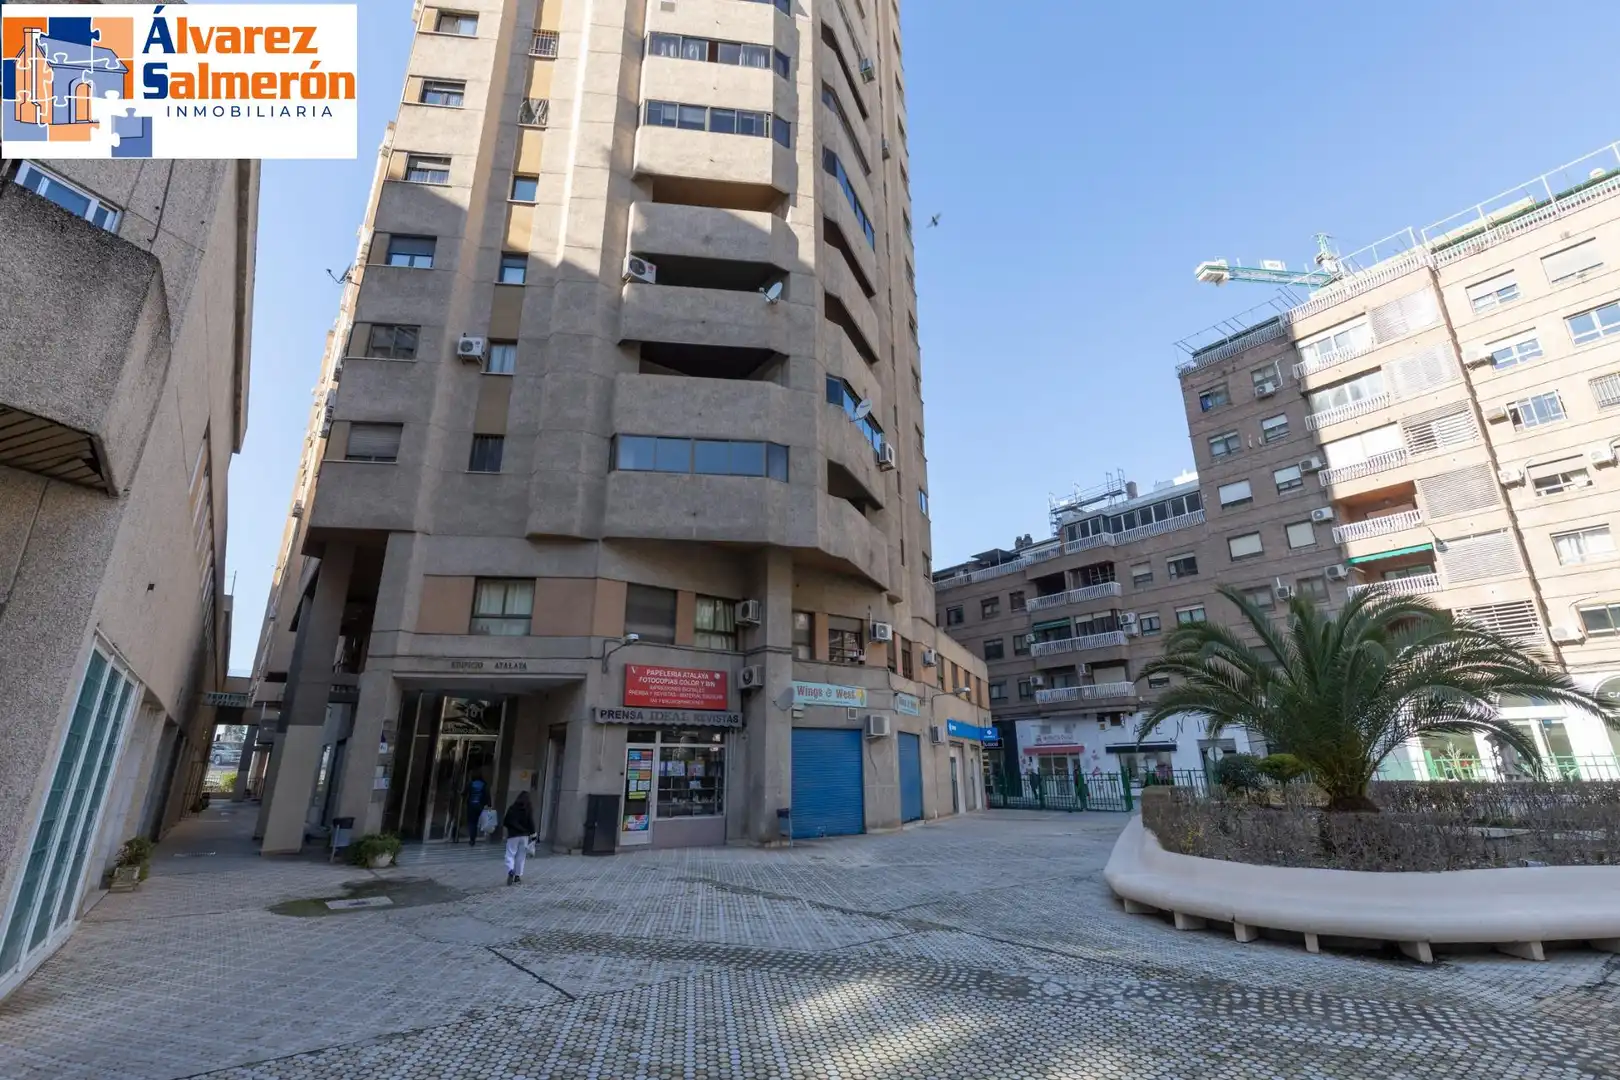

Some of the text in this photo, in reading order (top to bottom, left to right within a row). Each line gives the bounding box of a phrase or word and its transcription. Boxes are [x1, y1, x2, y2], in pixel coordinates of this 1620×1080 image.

[494, 661, 527, 670] ATALAYA
[682, 671, 709, 680] ATALAYA
[639, 676, 678, 685] FOTOCOPIAS
[679, 679, 700, 687] COLOR
[796, 685, 824, 699] Wings
[600, 709, 643, 720] PRENSA
[694, 713, 739, 724] REVISTAS
